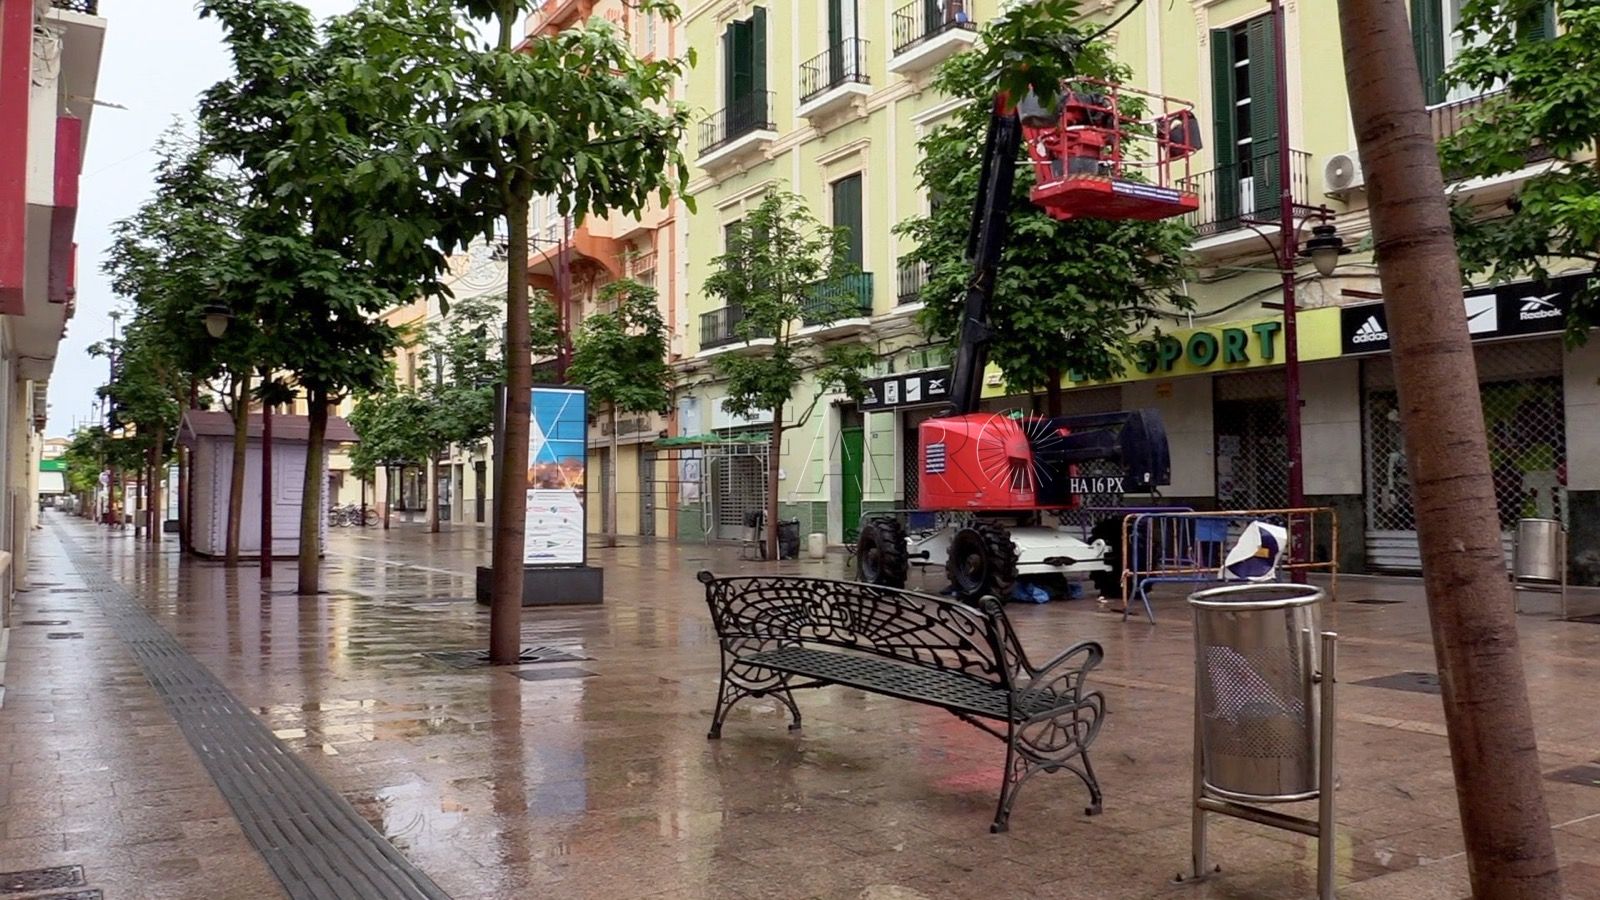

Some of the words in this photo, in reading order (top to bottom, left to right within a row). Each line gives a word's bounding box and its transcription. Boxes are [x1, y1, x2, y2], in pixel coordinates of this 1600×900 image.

[1519, 308, 1562, 321] Reebok
[1352, 331, 1388, 344] adidas
[1134, 321, 1282, 374] SPORT
[1070, 477, 1089, 493] HA
[1092, 477, 1105, 493] 16
[1107, 477, 1124, 493] PX
